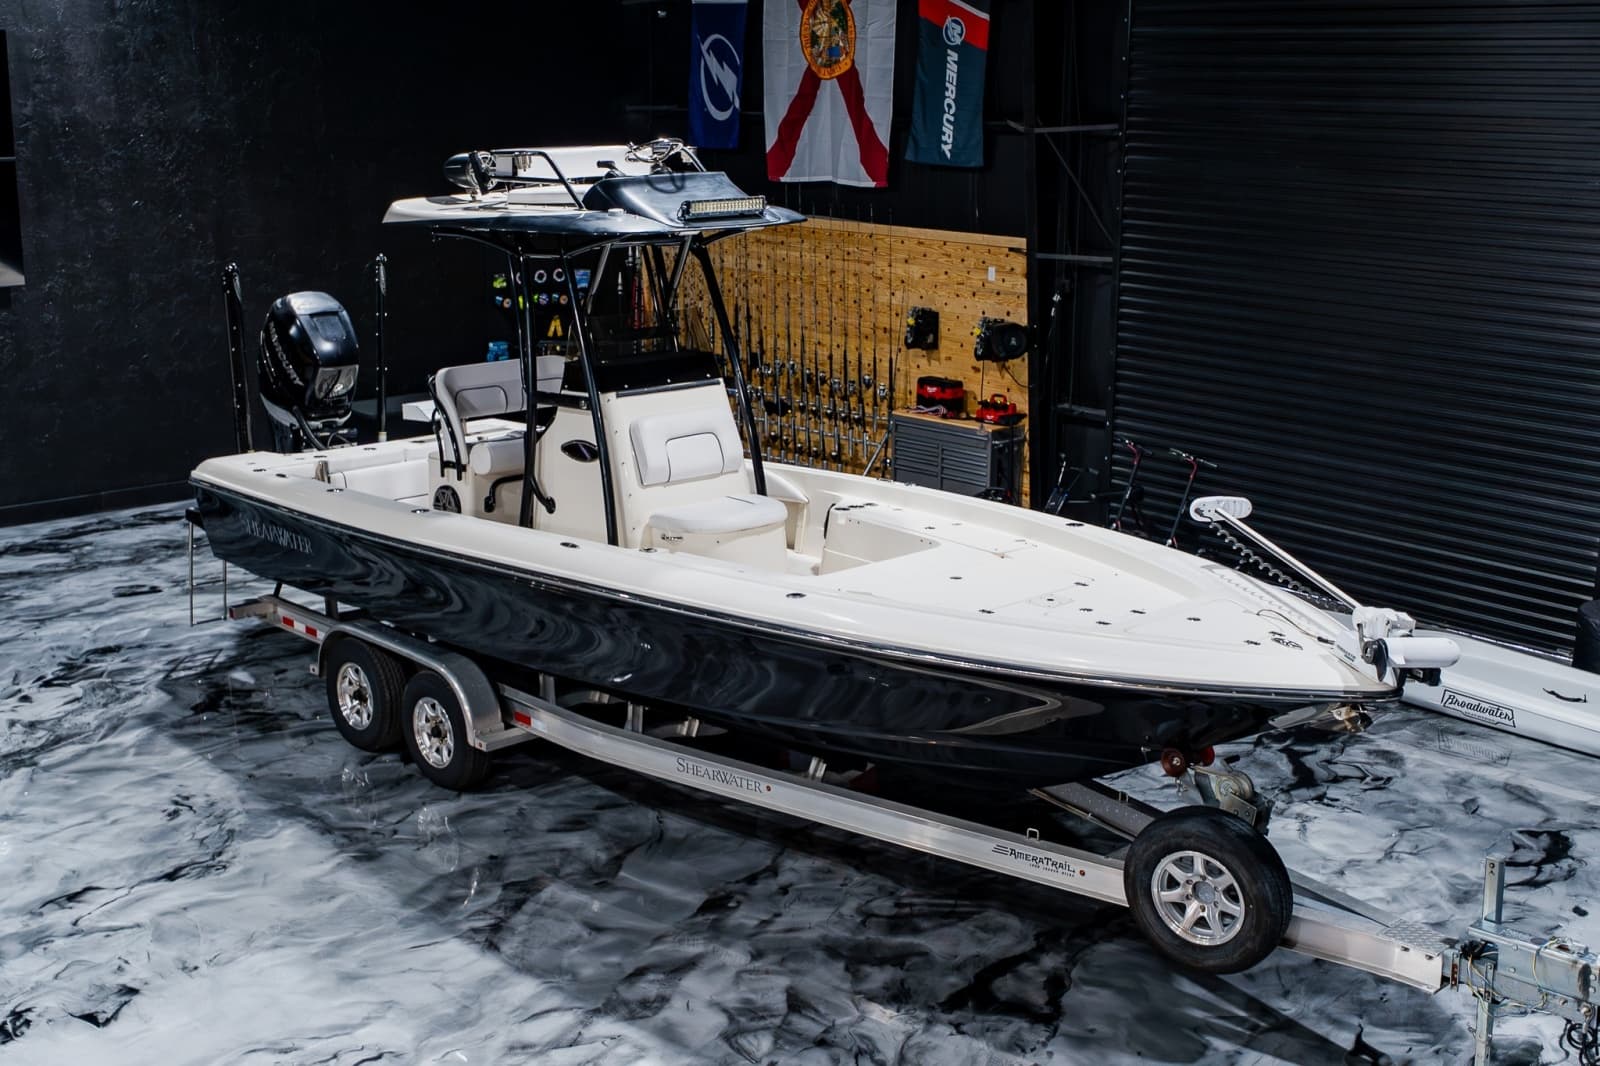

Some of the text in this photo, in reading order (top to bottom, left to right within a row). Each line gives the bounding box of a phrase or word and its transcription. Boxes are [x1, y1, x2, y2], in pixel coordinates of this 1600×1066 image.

[939, 49, 960, 160] MERCURY
[1445, 694, 1514, 721] Broadwater
[676, 756, 763, 793] SHEARWATER
